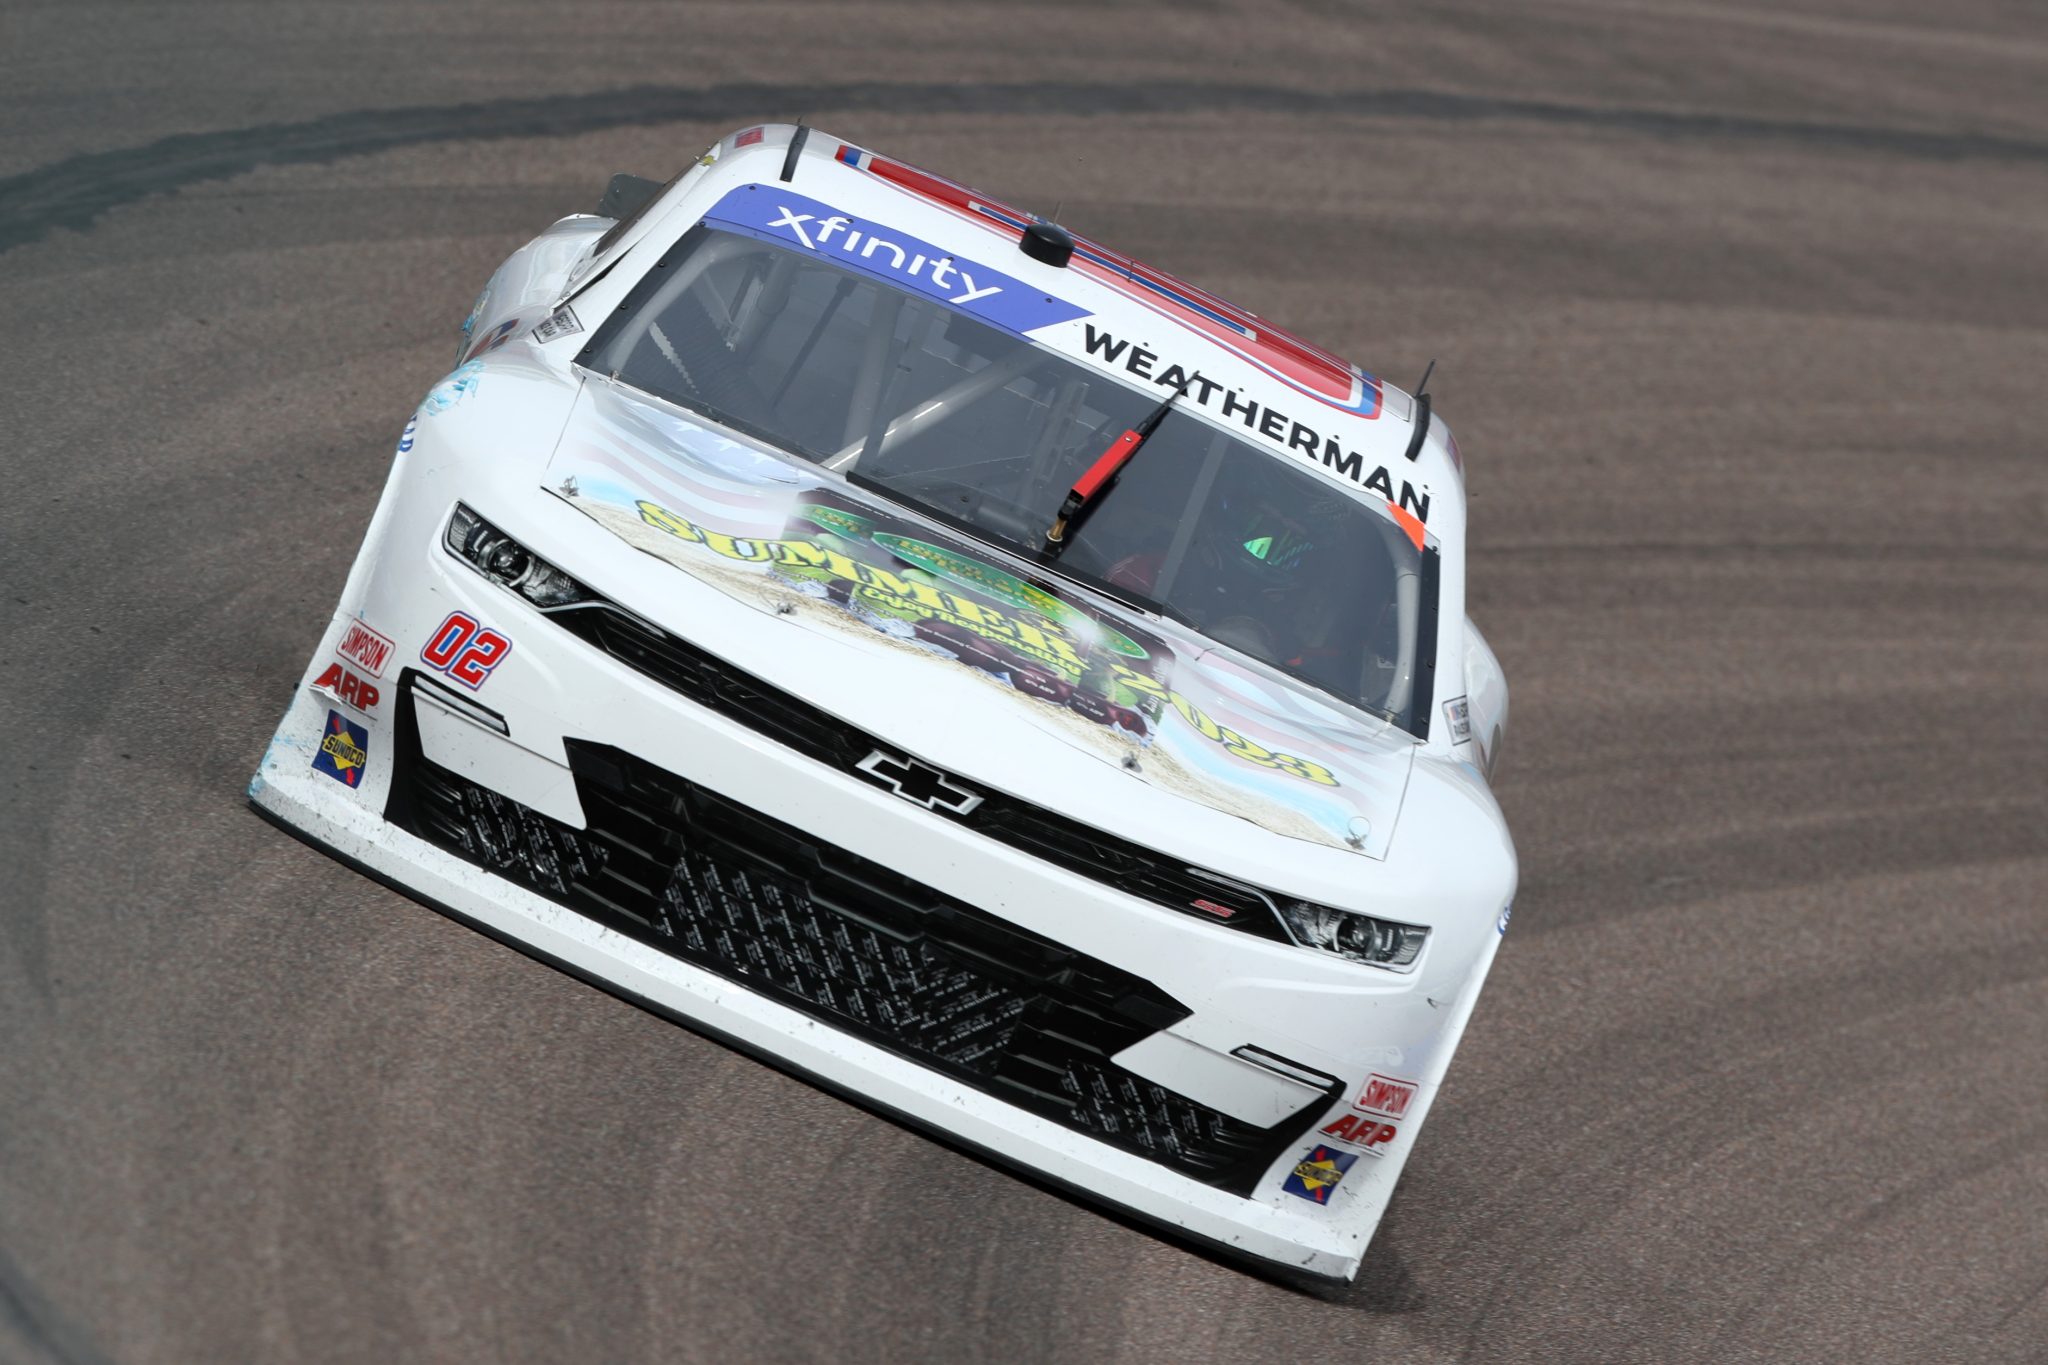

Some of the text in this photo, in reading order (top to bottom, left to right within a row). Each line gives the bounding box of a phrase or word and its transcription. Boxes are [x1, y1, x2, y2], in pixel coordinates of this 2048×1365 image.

[767, 206, 1003, 304] xfinity
[1083, 323, 1430, 522] WEATHERMAN
[862, 585, 935, 619] Enjoy
[340, 622, 389, 672] SIMPSON
[420, 610, 513, 692] 02
[634, 499, 1341, 788] SUMMER 2023
[313, 662, 380, 711] ARP
[324, 735, 365, 770] SUNOCO
[1322, 1113, 1397, 1145] ARP
